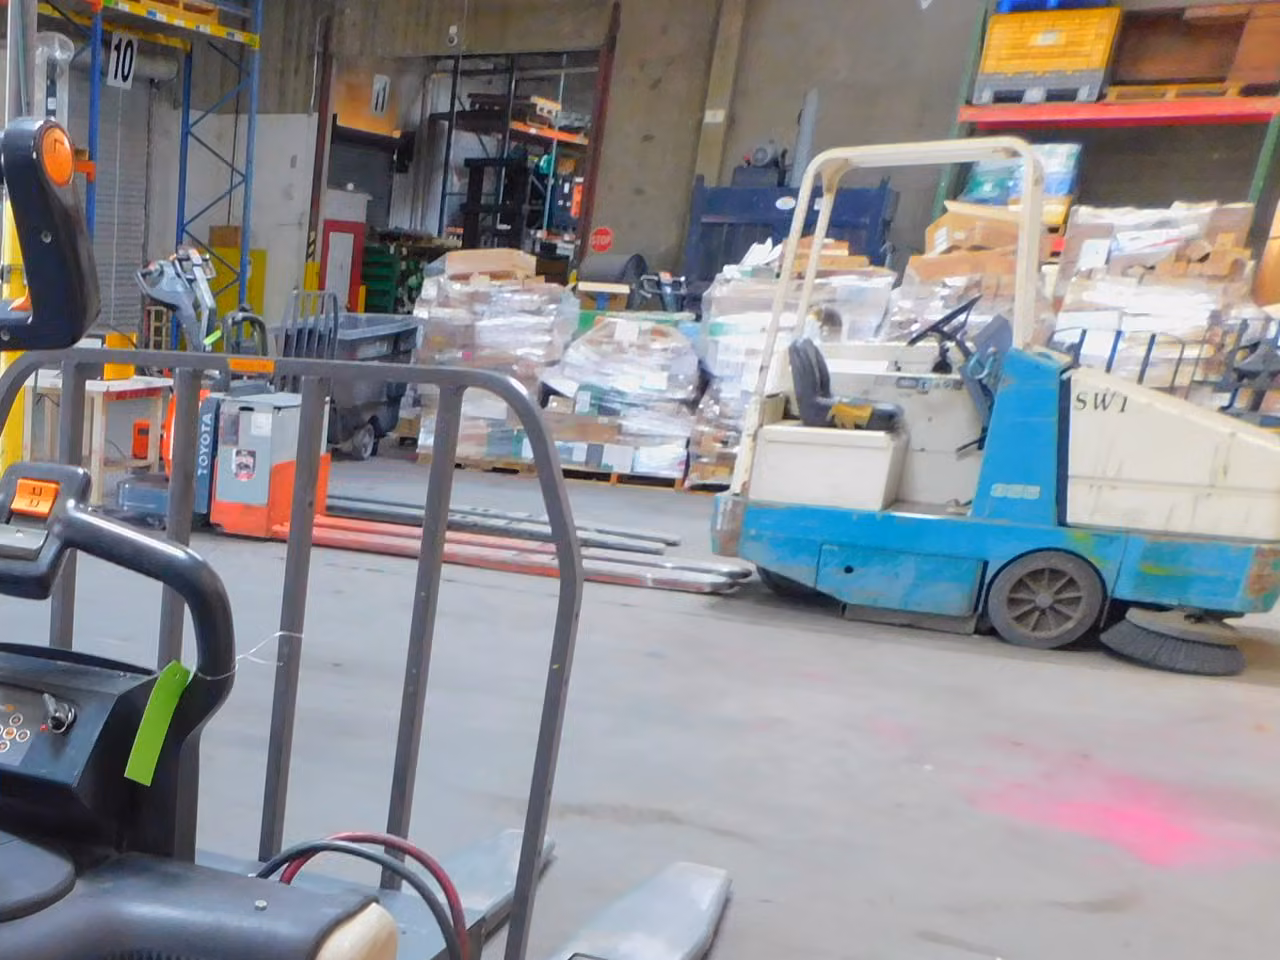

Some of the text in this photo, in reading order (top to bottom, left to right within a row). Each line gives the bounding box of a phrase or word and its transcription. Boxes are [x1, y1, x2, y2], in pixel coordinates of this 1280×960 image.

[113, 38, 135, 83] 10
[591, 234, 612, 246] STOP
[197, 412, 212, 477] TOYOTA
